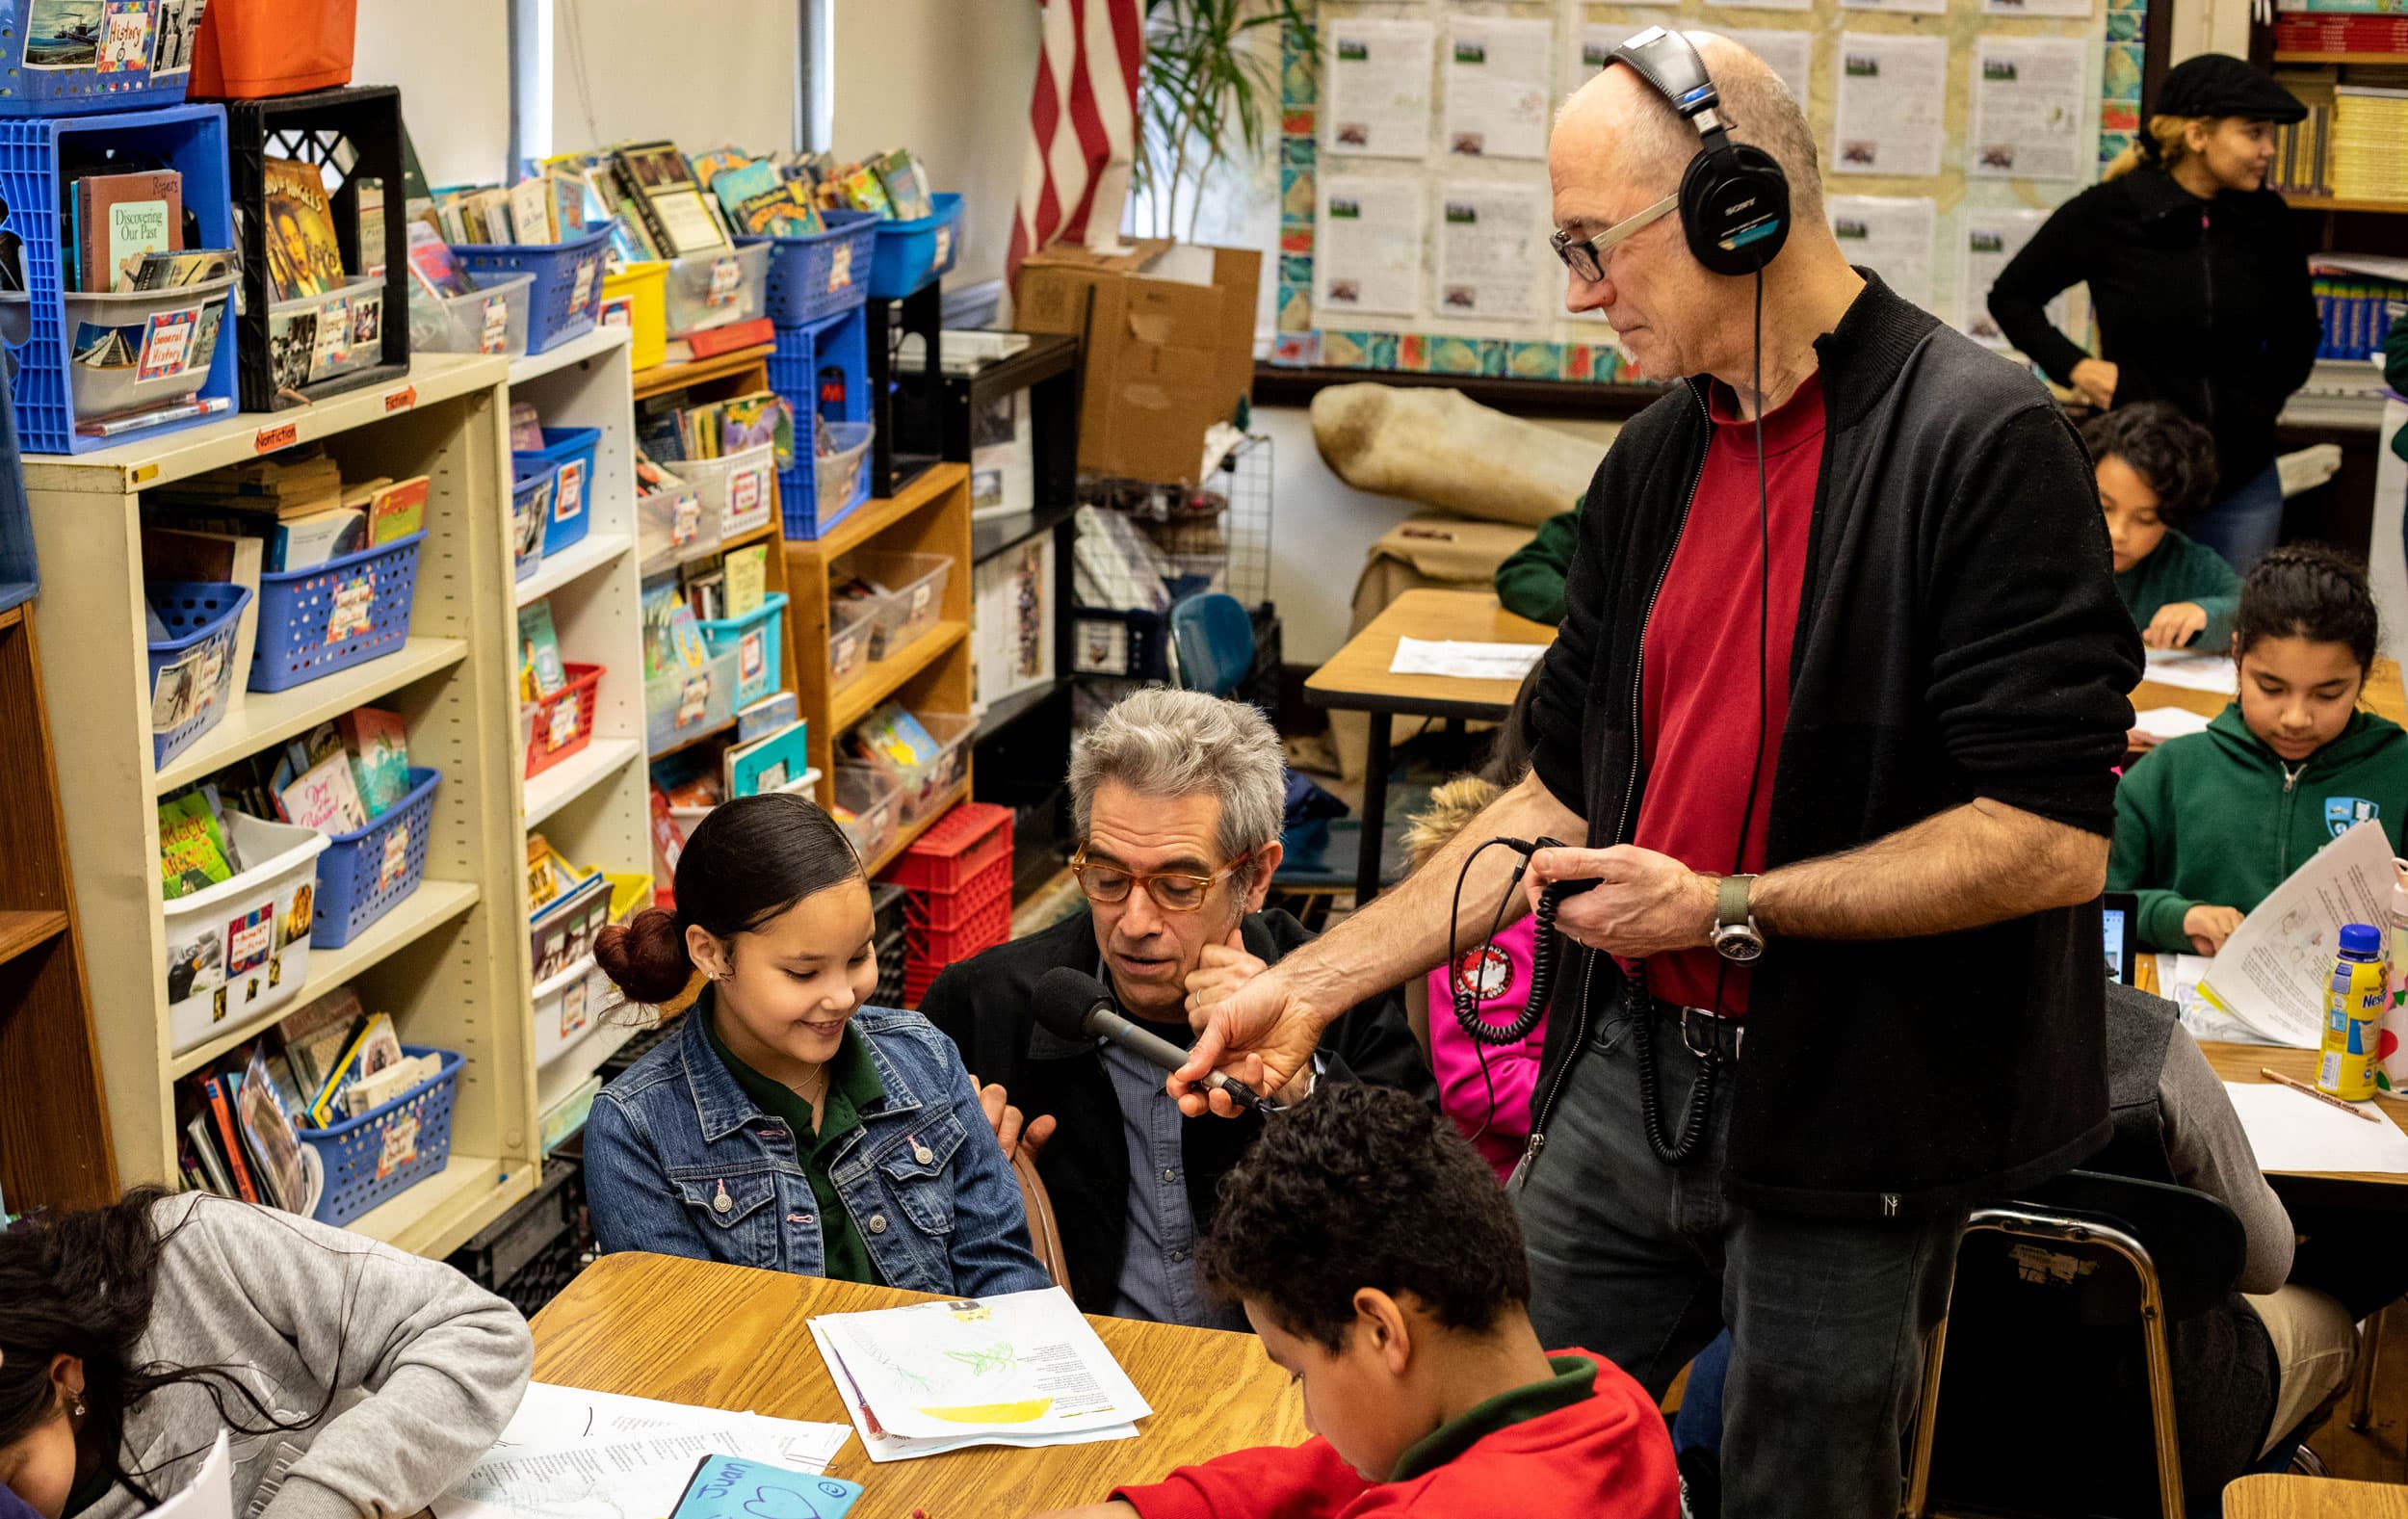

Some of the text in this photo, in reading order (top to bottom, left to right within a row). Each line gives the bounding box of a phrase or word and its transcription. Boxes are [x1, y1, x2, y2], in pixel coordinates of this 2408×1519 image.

[109, 19, 143, 48] History
[152, 176, 179, 198] Rogers
[1724, 196, 1757, 217] SONY
[116, 208, 163, 227] Discovering
[120, 223, 159, 241] Our Past
[153, 328, 184, 345] General
[152, 350, 182, 364] History
[256, 426, 296, 448] Nonfiction
[696, 1462, 755, 1500] Juan
